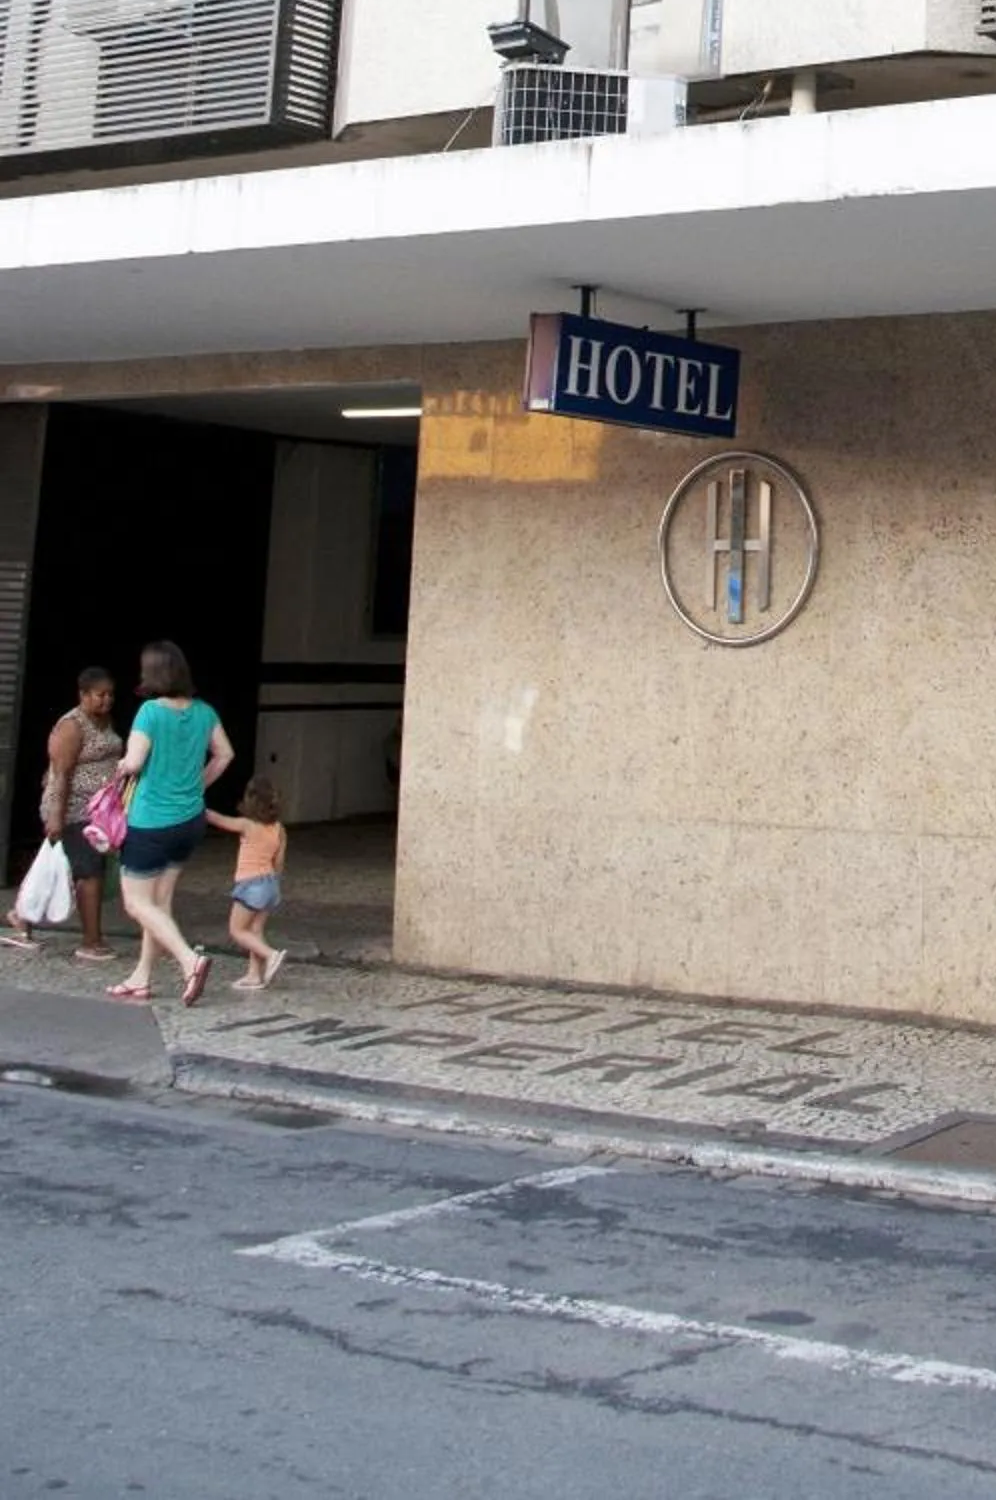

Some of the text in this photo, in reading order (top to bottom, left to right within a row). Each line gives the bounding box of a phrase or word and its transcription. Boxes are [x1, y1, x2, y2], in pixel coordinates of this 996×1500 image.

[564, 335, 733, 421] HOTEL
[206, 1013, 904, 1113] IMPERIAL
[394, 993, 850, 1059] HOTEL
